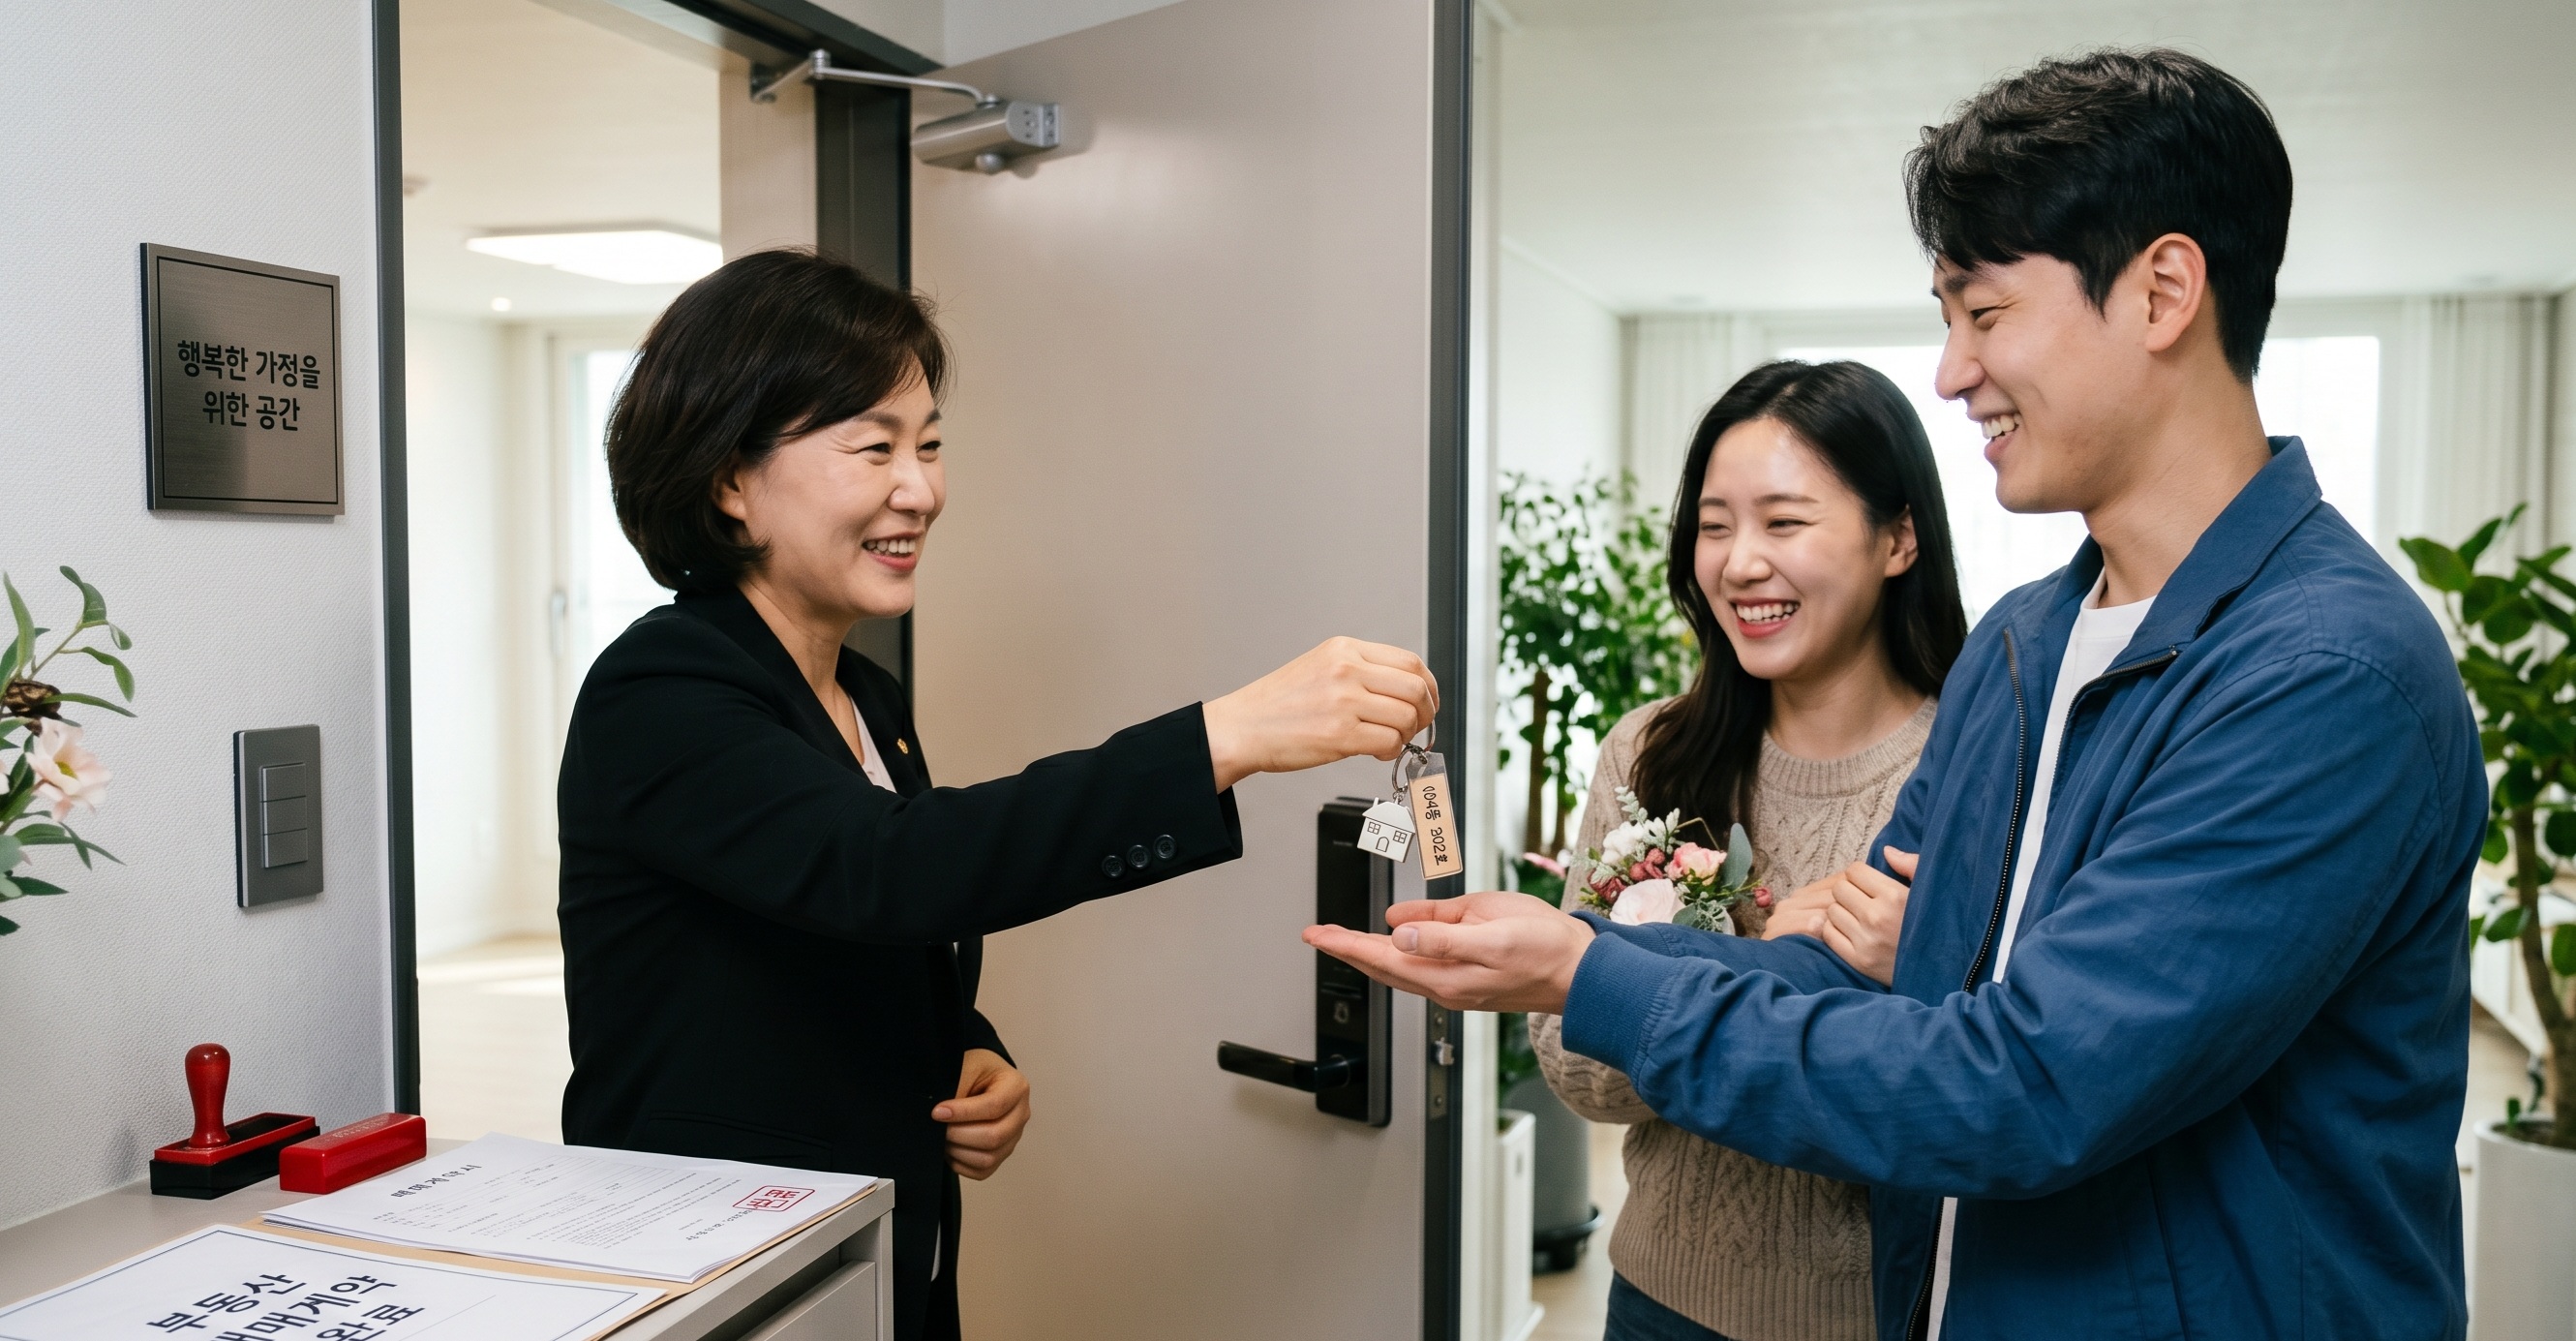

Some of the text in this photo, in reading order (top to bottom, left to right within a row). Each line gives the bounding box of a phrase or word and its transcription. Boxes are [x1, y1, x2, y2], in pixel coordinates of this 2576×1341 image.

[177, 340, 320, 389] 행복한 가정을
[202, 391, 300, 431] 위한 공간
[146, 1274, 307, 1333] 부동산
